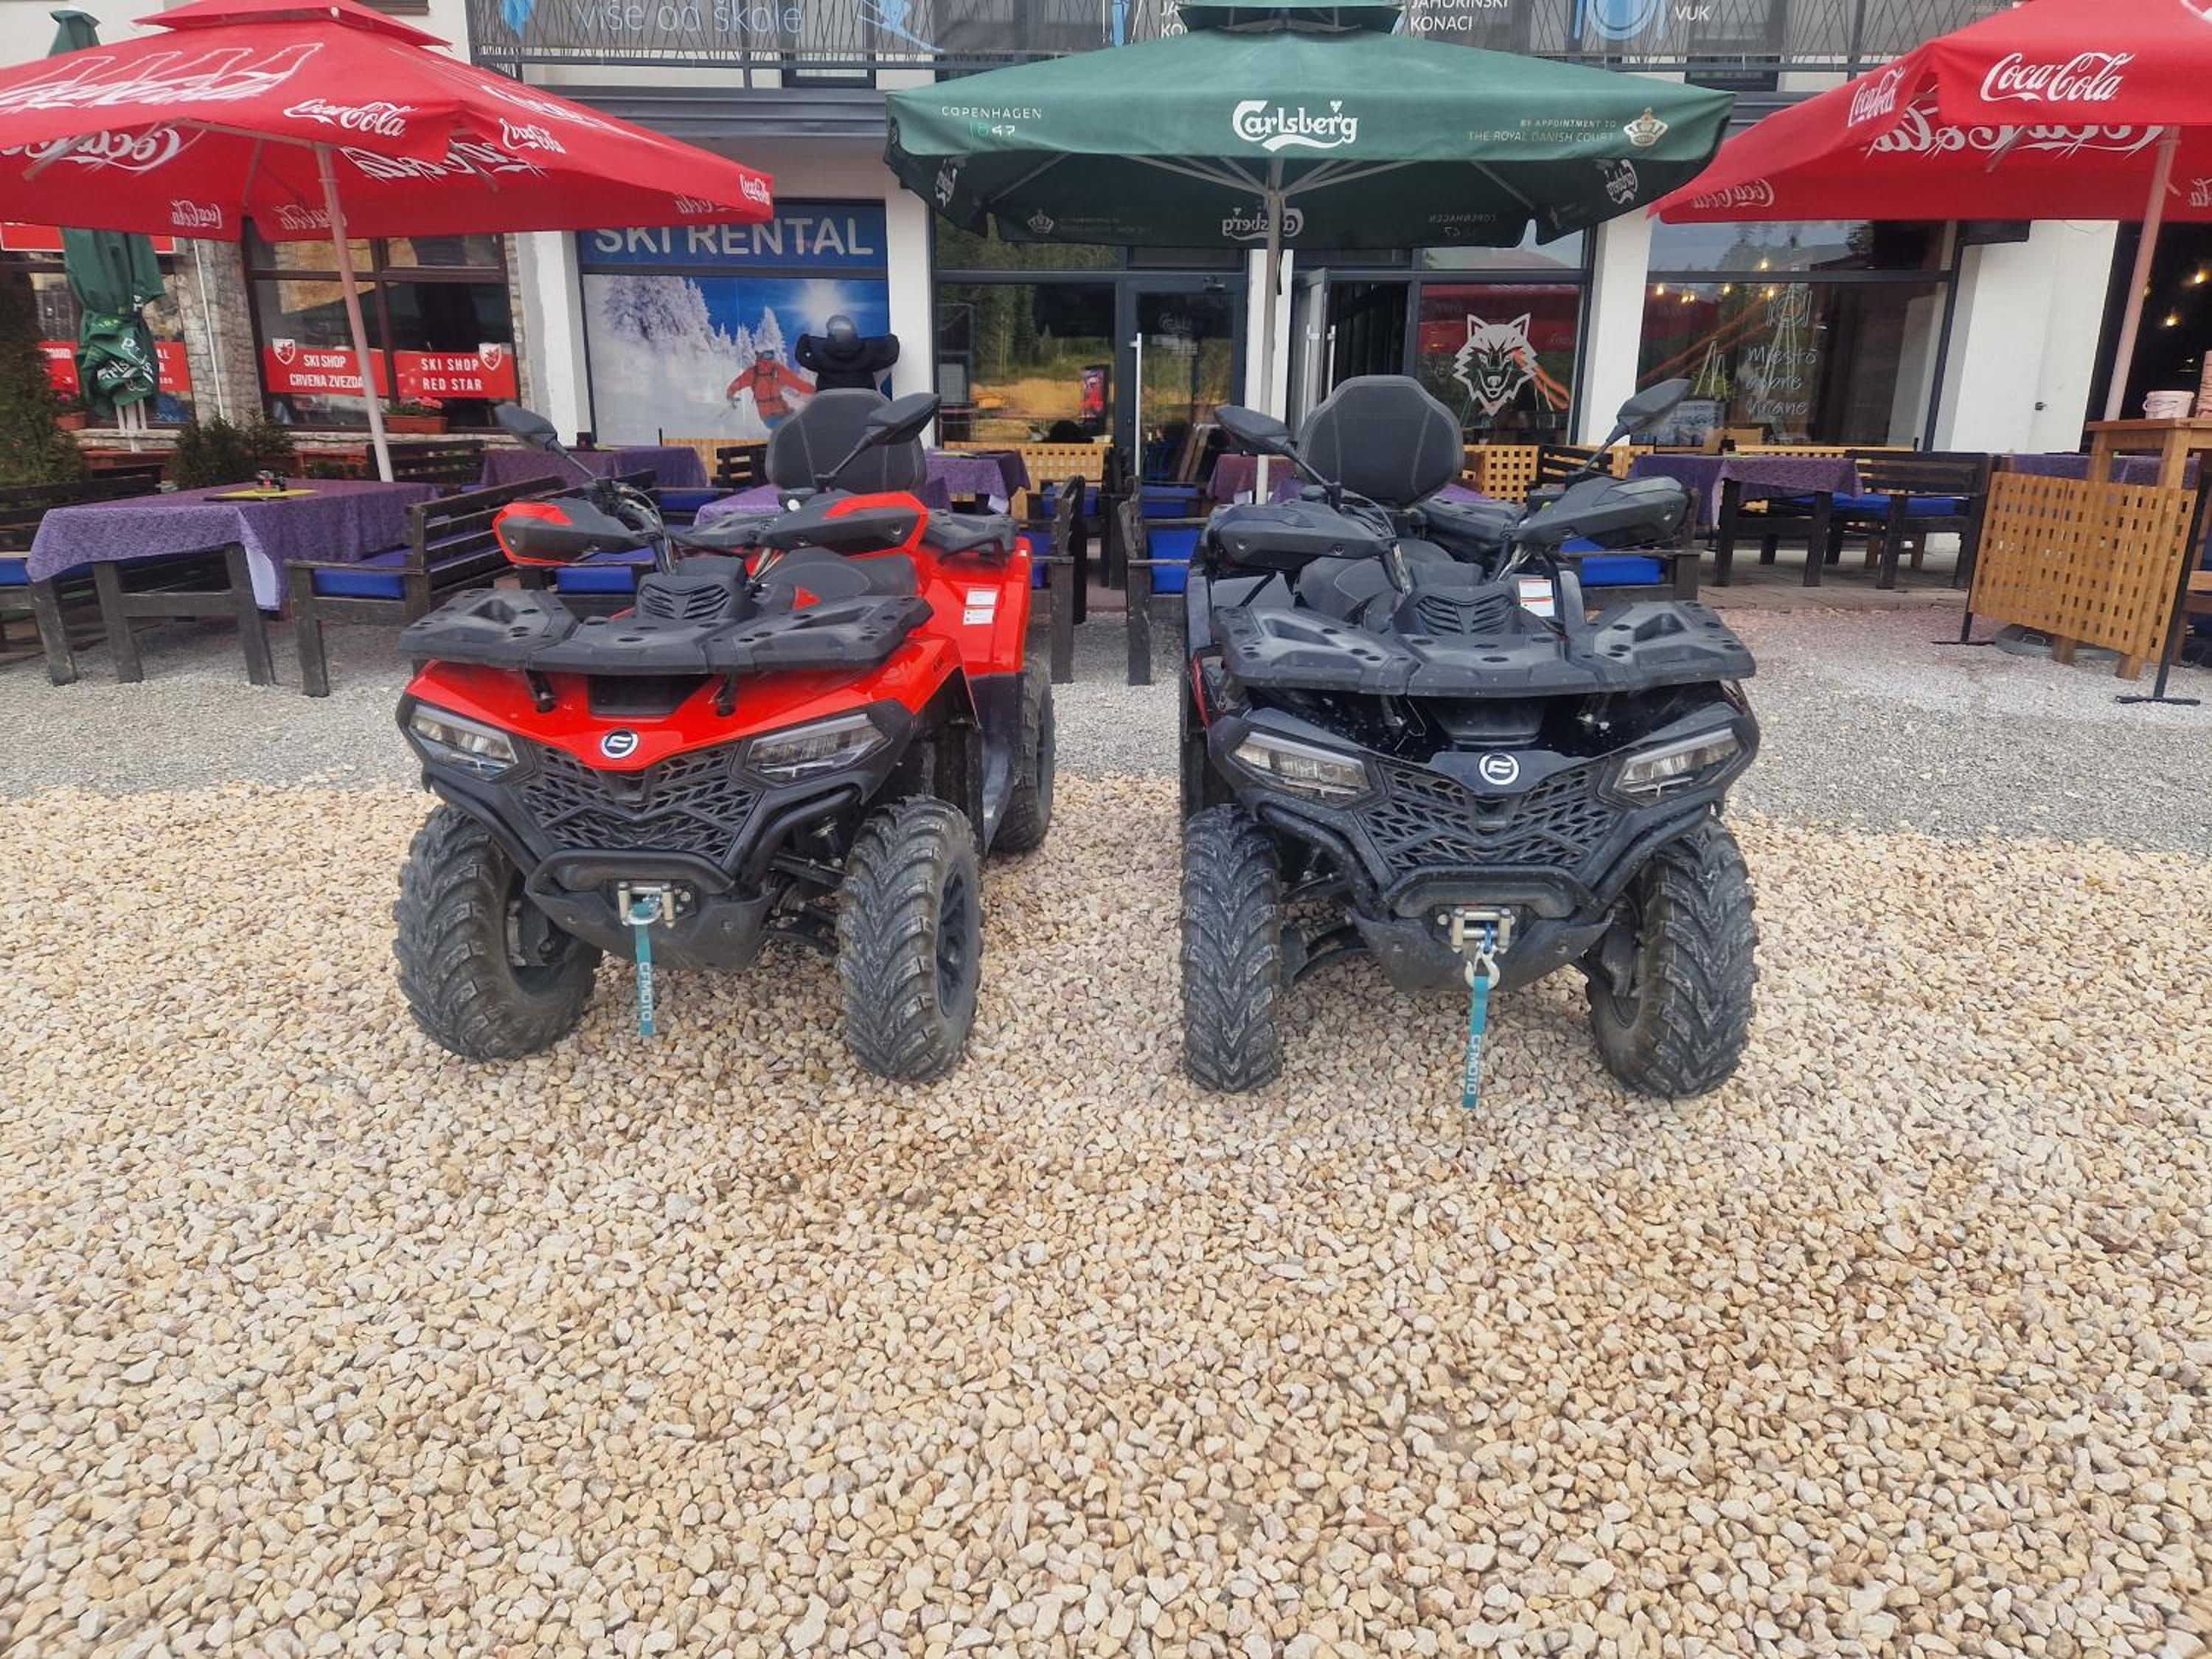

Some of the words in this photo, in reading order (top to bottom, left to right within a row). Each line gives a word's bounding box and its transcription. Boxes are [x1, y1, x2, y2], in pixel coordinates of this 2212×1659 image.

[657, 0, 700, 31] od
[1675, 5, 1710, 21] VUK
[1410, 15, 1472, 31] KONACI
[1980, 52, 2135, 101] Coca-Cola
[941, 106, 1042, 119] COPENHAGEN
[1232, 100, 1359, 152] Carlsberg
[595, 226, 670, 254] SKI
[687, 218, 874, 256] RENTAL
[303, 354, 320, 367] SKI
[321, 355, 346, 368] SHOP
[421, 358, 442, 371] SKI
[447, 358, 479, 371] SHOP
[289, 373, 327, 387] CRVENA
[422, 377, 446, 391] RED
[451, 378, 482, 392] STAR
[640, 962, 653, 1021] CFMOTO
